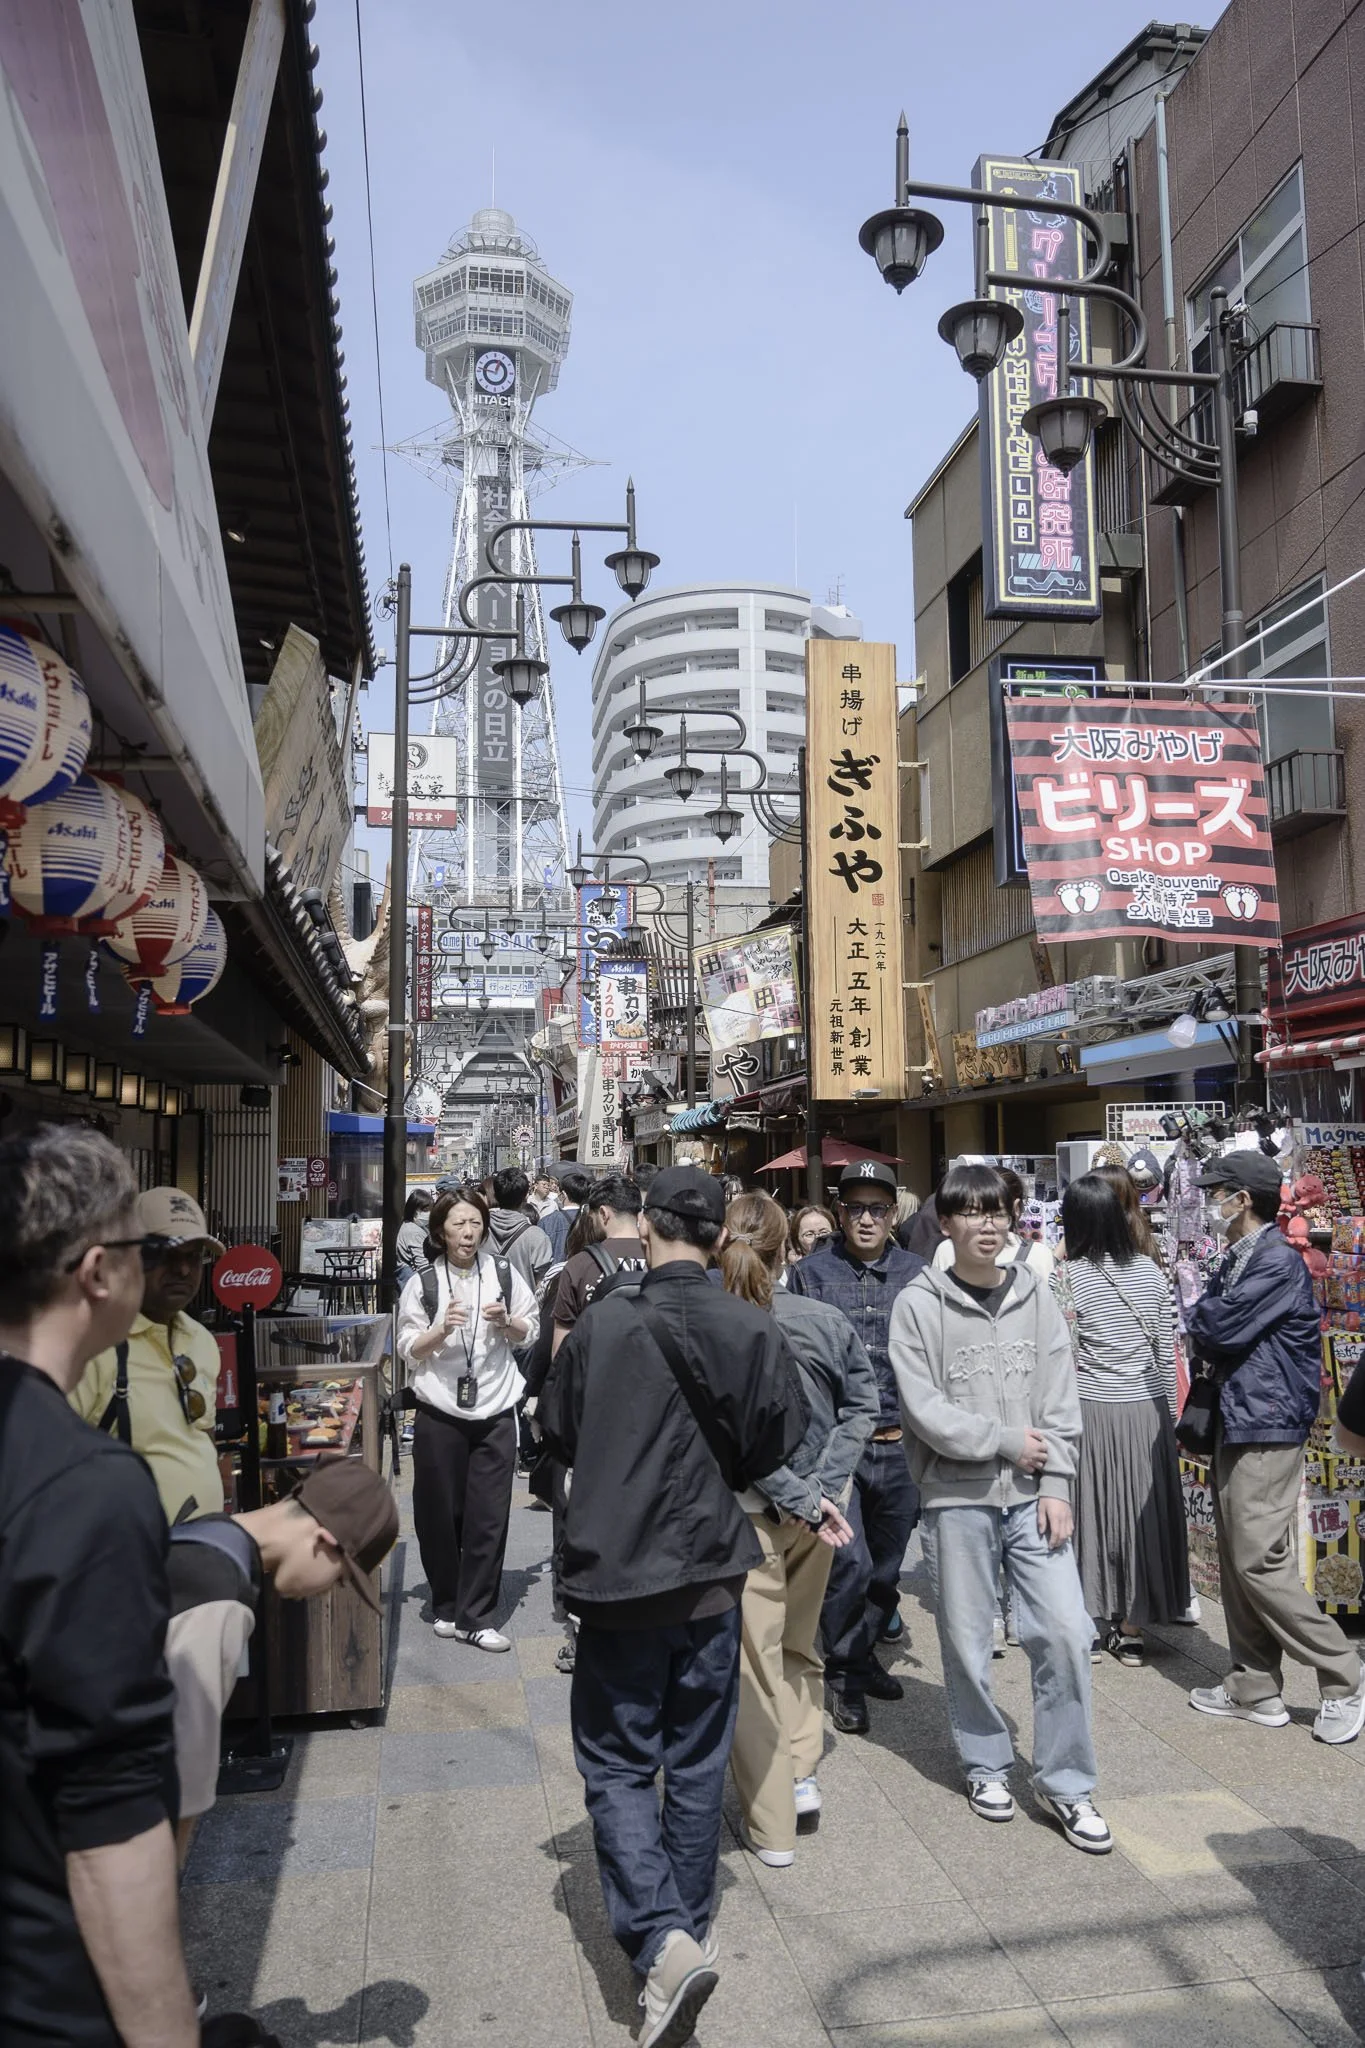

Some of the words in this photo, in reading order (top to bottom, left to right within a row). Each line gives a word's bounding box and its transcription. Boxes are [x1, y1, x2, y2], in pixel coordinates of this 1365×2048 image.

[472, 394, 519, 407] HITACH
[1013, 477, 1031, 542] LAB
[481, 485, 510, 762] 社会イベーョンの日立
[839, 663, 865, 736] 串揚げ
[1052, 728, 1224, 764] 大阪みやげ
[410, 781, 444, 801] 亀家
[1038, 771, 1254, 840] ビリーズ
[48, 821, 98, 840] Asahi
[826, 748, 884, 894] ぎふや
[1106, 837, 1208, 866] SHOP
[1109, 870, 1155, 885] Osaka
[1157, 875, 1220, 890] souvenir
[492, 934, 534, 948] SAK
[874, 922, 887, 971] 一九一六年
[1285, 935, 1365, 996] 大阪み
[611, 963, 635, 973] Asahi
[616, 975, 640, 1025] 串カツ
[846, 917, 873, 1077] 大正五年創業
[829, 999, 845, 1076] 元祖新世界
[978, 1031, 1000, 1046] CLAW
[1002, 1018, 1045, 1040] MACHINE
[1047, 1012, 1067, 1028] LAB
[715, 1047, 760, 1098] や
[592, 1124, 600, 1158] 通天閣店
